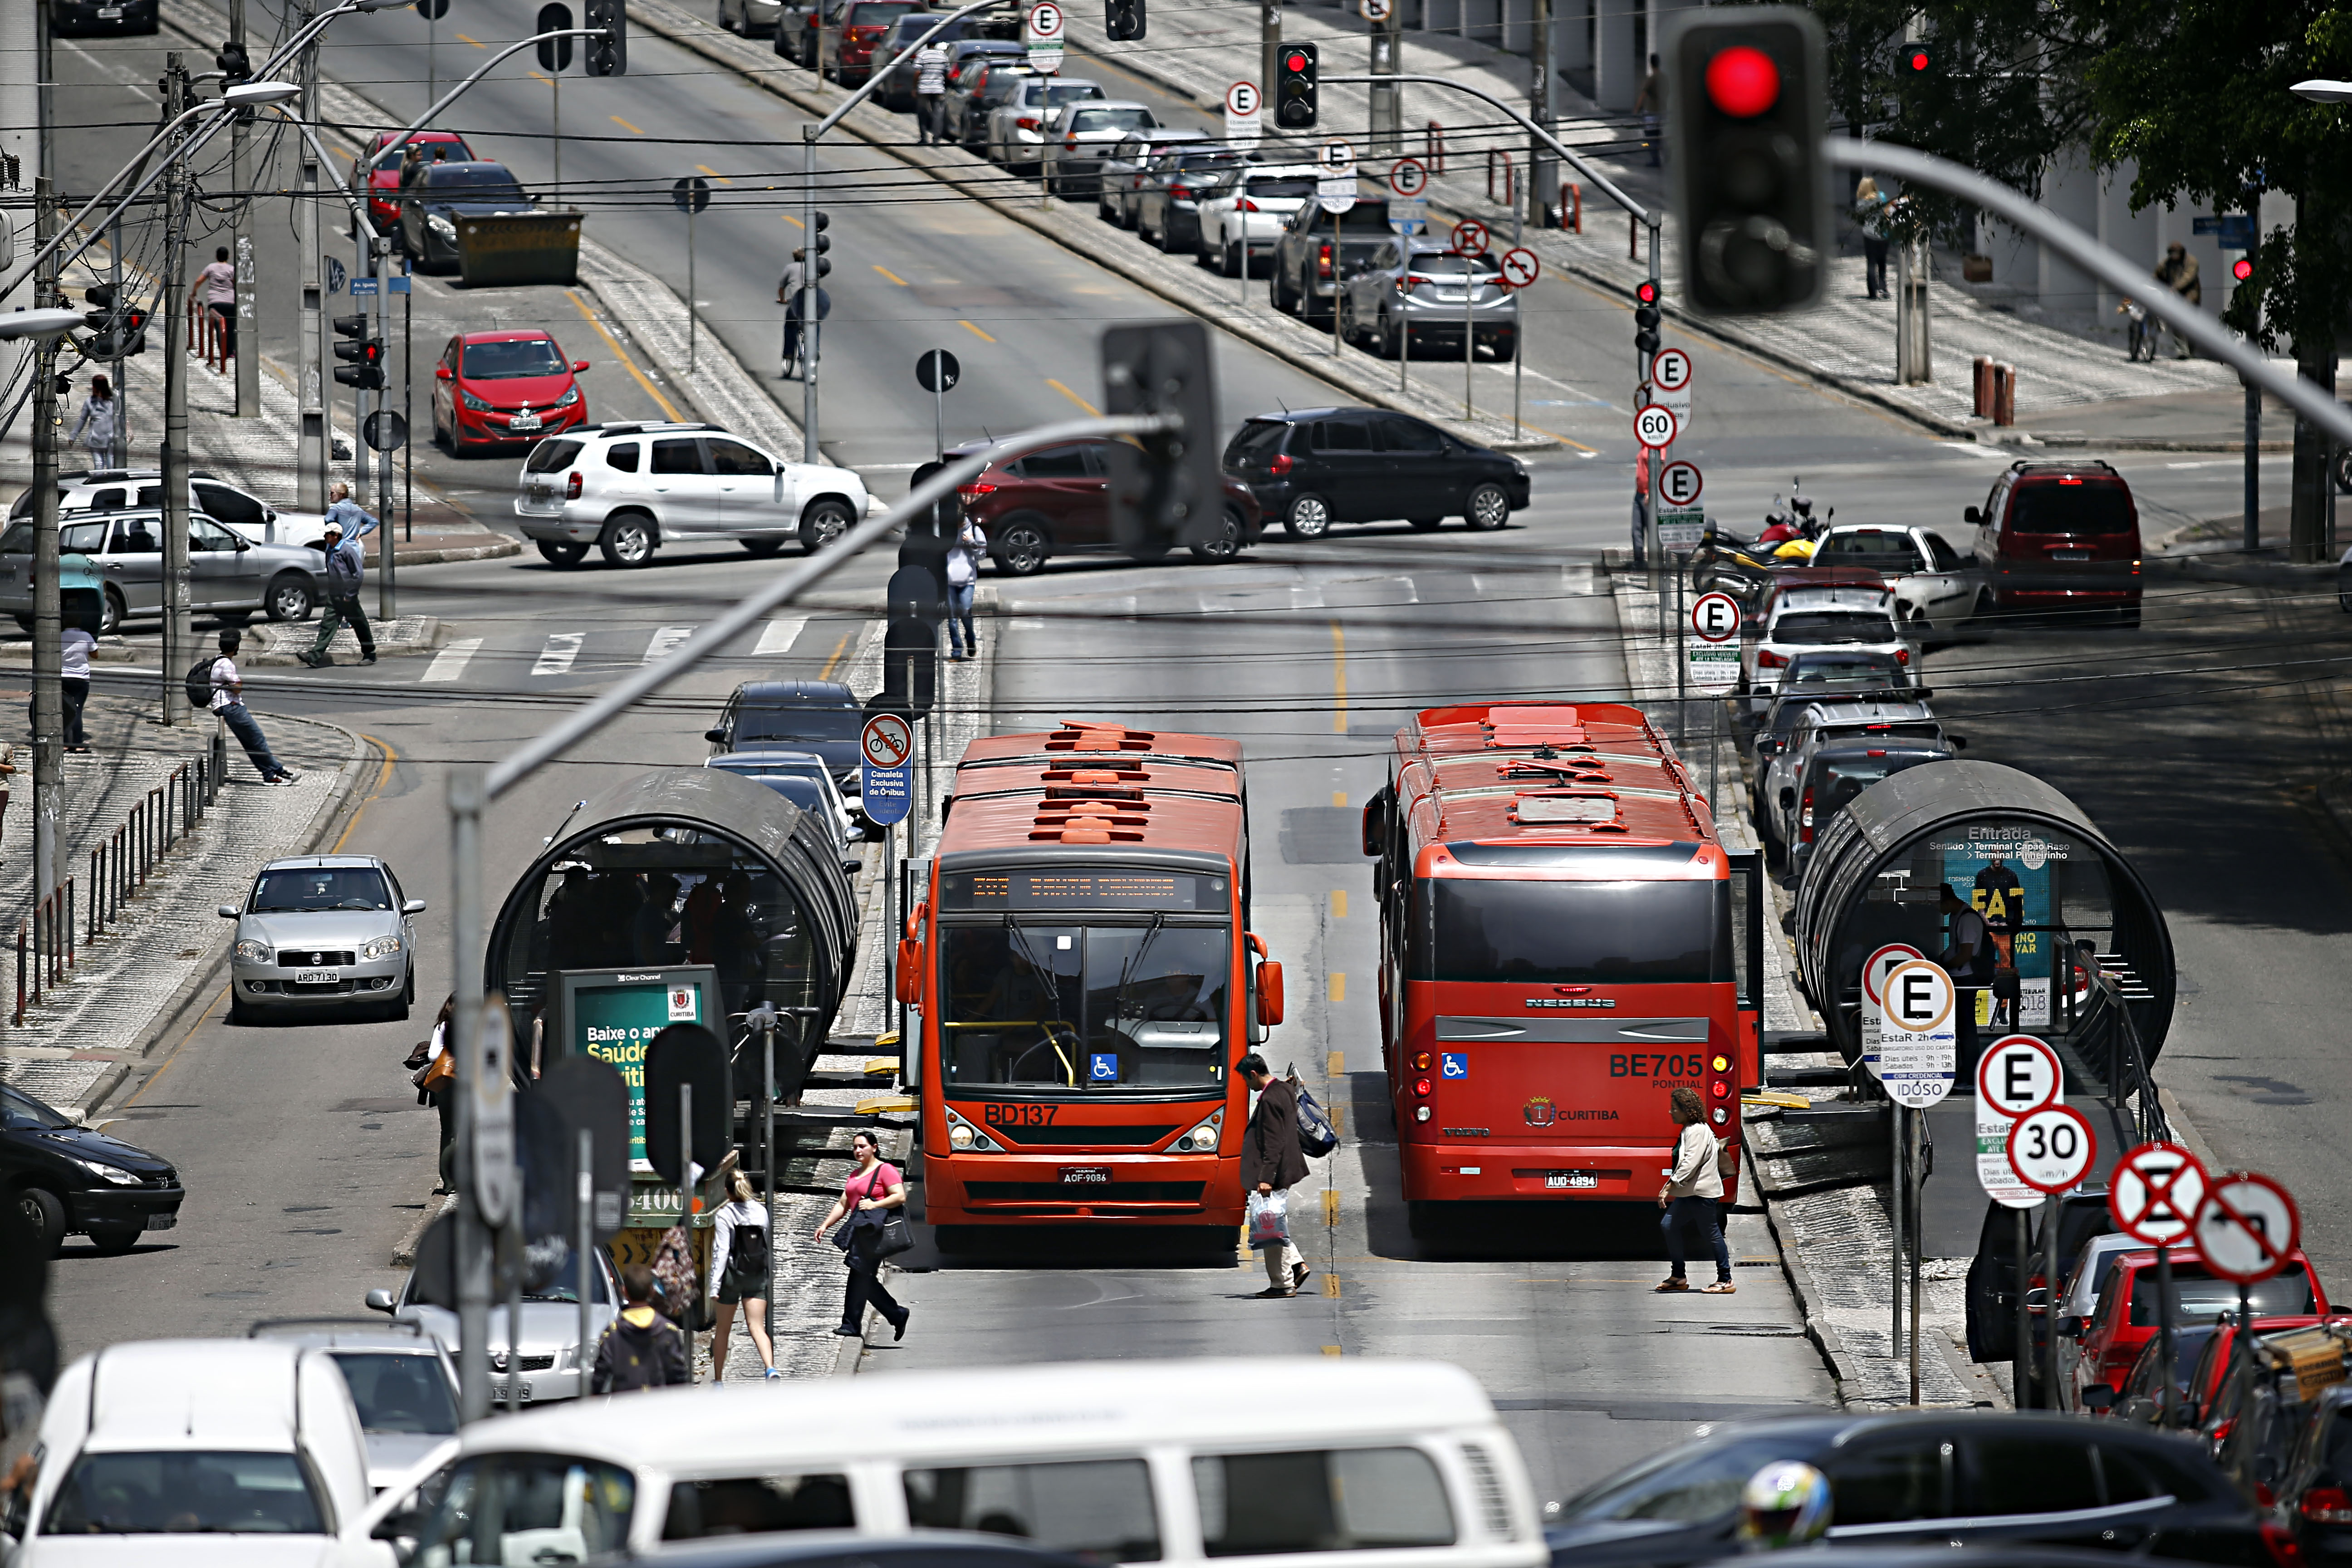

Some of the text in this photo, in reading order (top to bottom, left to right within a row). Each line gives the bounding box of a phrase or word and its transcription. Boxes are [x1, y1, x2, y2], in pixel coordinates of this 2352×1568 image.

[1040, 10, 1052, 29] E
[1238, 89, 1249, 108] E
[1330, 145, 1344, 166] E
[1402, 167, 1415, 187] E
[1666, 358, 1679, 381] E
[1642, 415, 1668, 438] 60
[1673, 469, 1688, 496] E
[1707, 603, 1725, 631] E
[880, 787, 906, 796] Ônibus
[1969, 827, 2032, 840] Entrada
[1974, 851, 2013, 859] Terminal
[2015, 841, 2043, 852] Capão
[1526, 998, 1616, 1009] NEOBUS
[1903, 975, 1933, 1019] E
[588, 1026, 626, 1041] Baixe
[629, 1028, 639, 1039] o
[1882, 1033, 1929, 1042] EstaR 2h
[1610, 1054, 1703, 1077] BE705
[1652, 1080, 1703, 1088] PONTUAL
[2006, 1054, 2033, 1100] E
[1897, 1083, 1942, 1096] IDOSO
[985, 1104, 1059, 1126] BD137
[1558, 1110, 1619, 1121] CURITIBA
[1442, 1127, 1490, 1137] VOLVO
[2028, 1124, 2077, 1160] 30
